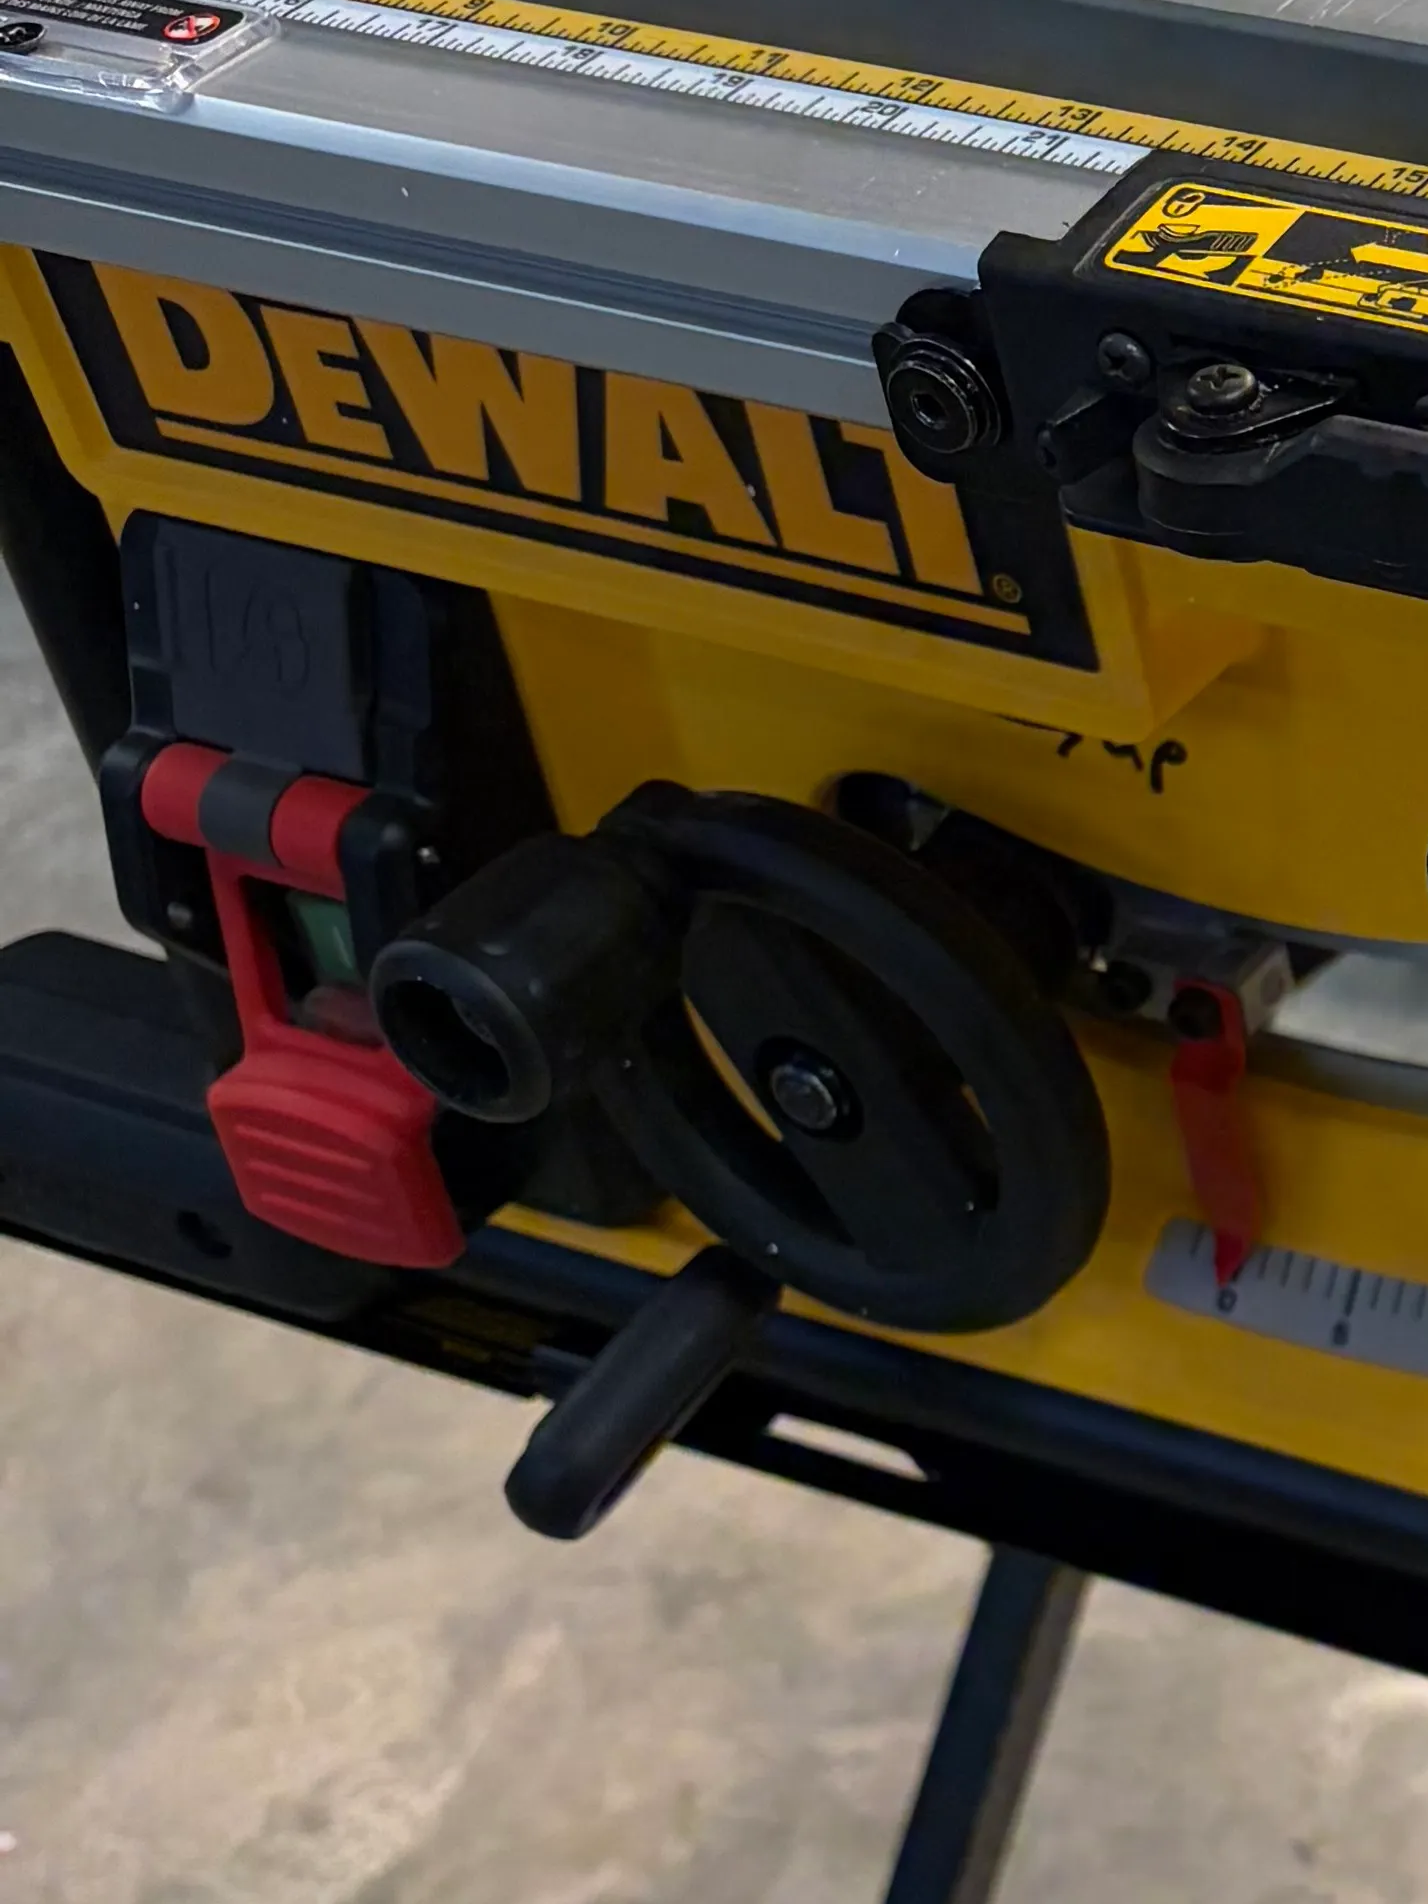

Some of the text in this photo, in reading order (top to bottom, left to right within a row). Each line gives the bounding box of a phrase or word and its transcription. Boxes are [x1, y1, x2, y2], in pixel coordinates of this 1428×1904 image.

[416, 18, 443, 35] 17
[562, 45, 593, 62] 18
[710, 71, 743, 89] 19
[863, 101, 897, 117] 20
[1022, 129, 1057, 145] 21
[598, 22, 628, 37] 10
[750, 49, 781, 65] 11
[900, 77, 932, 94] 12
[1058, 105, 1091, 122] 13
[1223, 135, 1258, 153] 14
[1392, 168, 1427, 184] 15
[94, 262, 985, 596] DEWALT
[1217, 1289, 1236, 1313] 0
